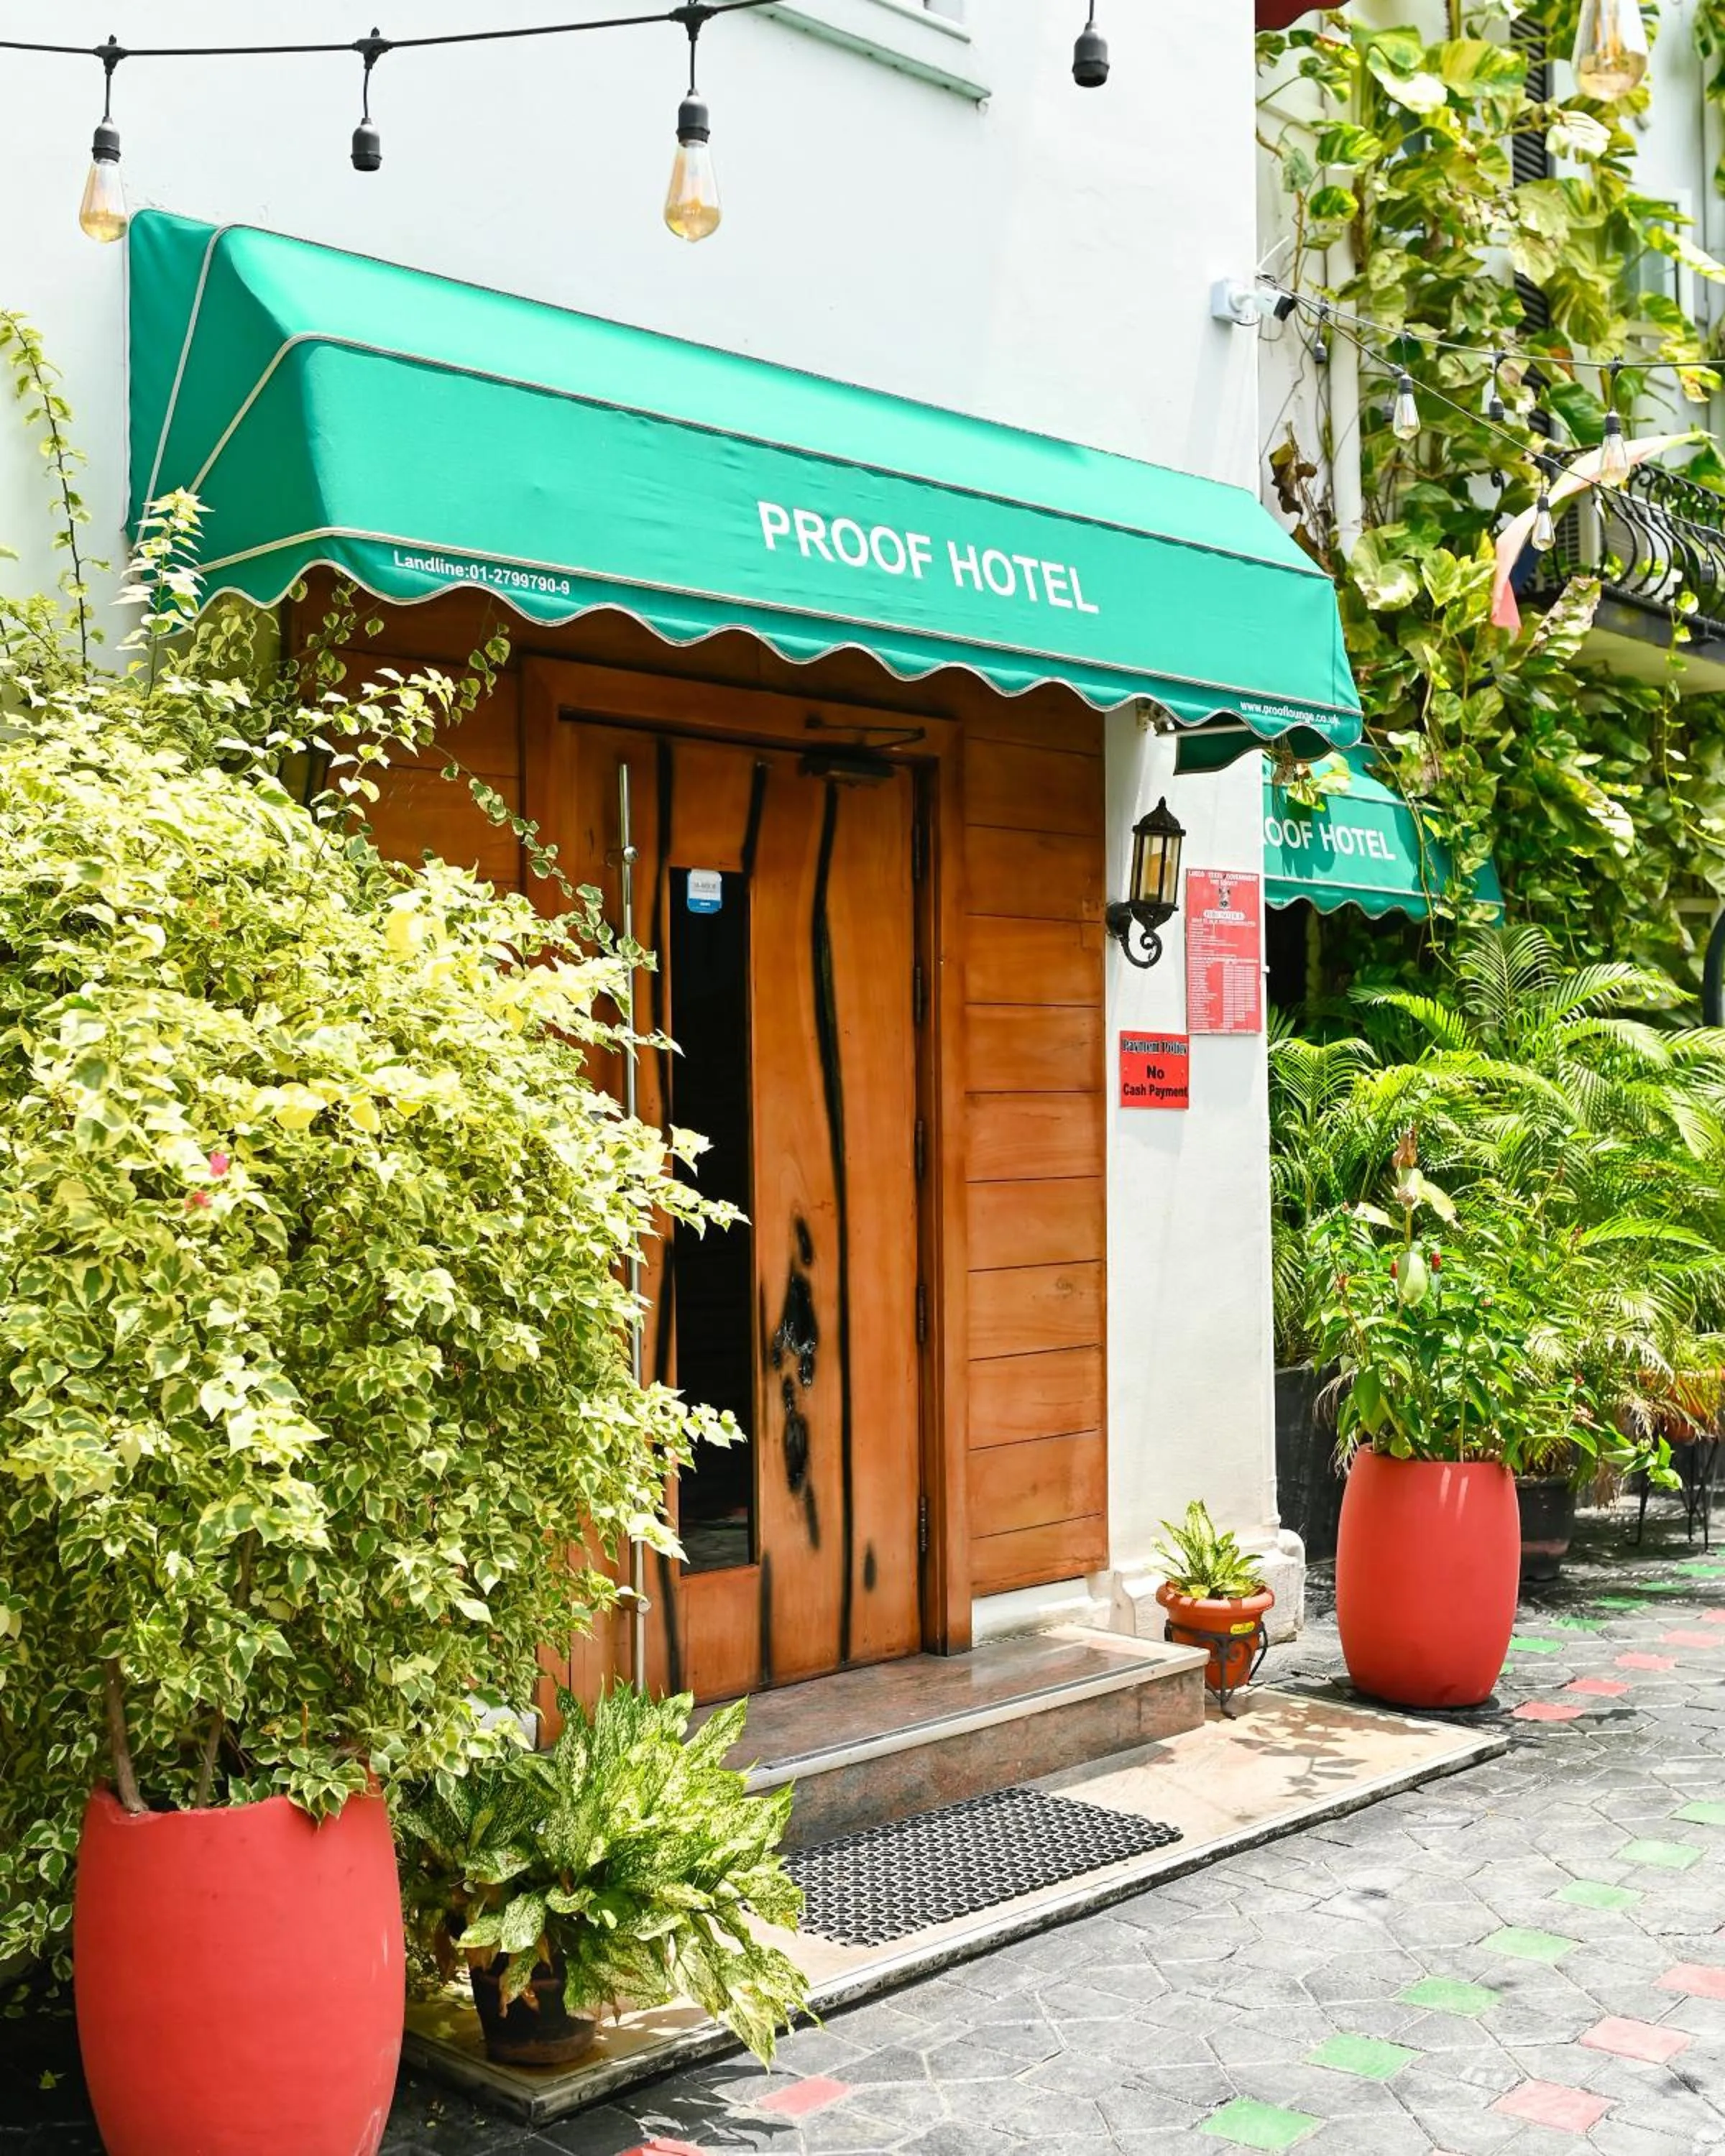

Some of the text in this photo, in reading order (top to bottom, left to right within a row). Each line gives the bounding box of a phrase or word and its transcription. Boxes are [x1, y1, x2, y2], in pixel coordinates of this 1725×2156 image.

[393, 550, 571, 596] Landline:01-2799790-9
[758, 501, 1100, 614] PROOF HOTEL
[1240, 701, 1340, 726] www.prooflounge.co.uk
[1263, 816, 1397, 860] OOF HOTEL
[1146, 1064, 1165, 1079] No
[1123, 1082, 1189, 1100] Cash Payment
